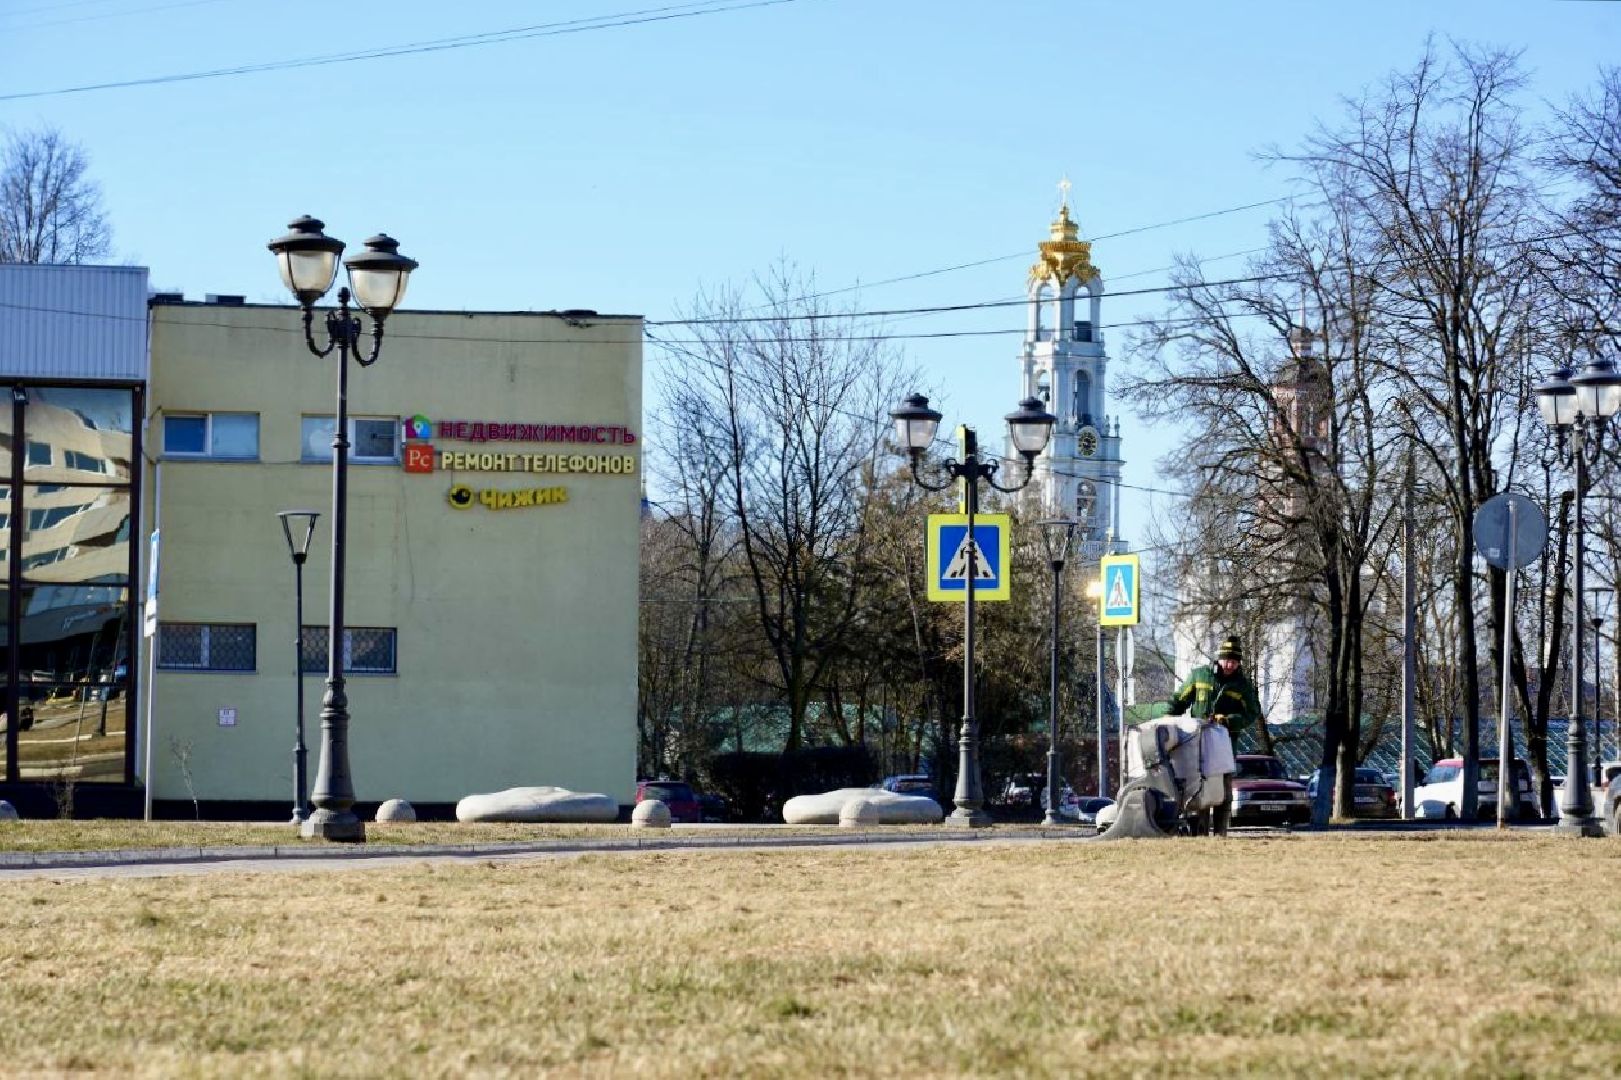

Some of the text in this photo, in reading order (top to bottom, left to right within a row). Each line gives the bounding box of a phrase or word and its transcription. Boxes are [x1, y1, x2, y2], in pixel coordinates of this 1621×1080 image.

[439, 420, 636, 443] НЕДВИЖИМОСТЬ
[441, 452, 634, 473] РЕМОНТ ТЕЛЕФОНОВ
